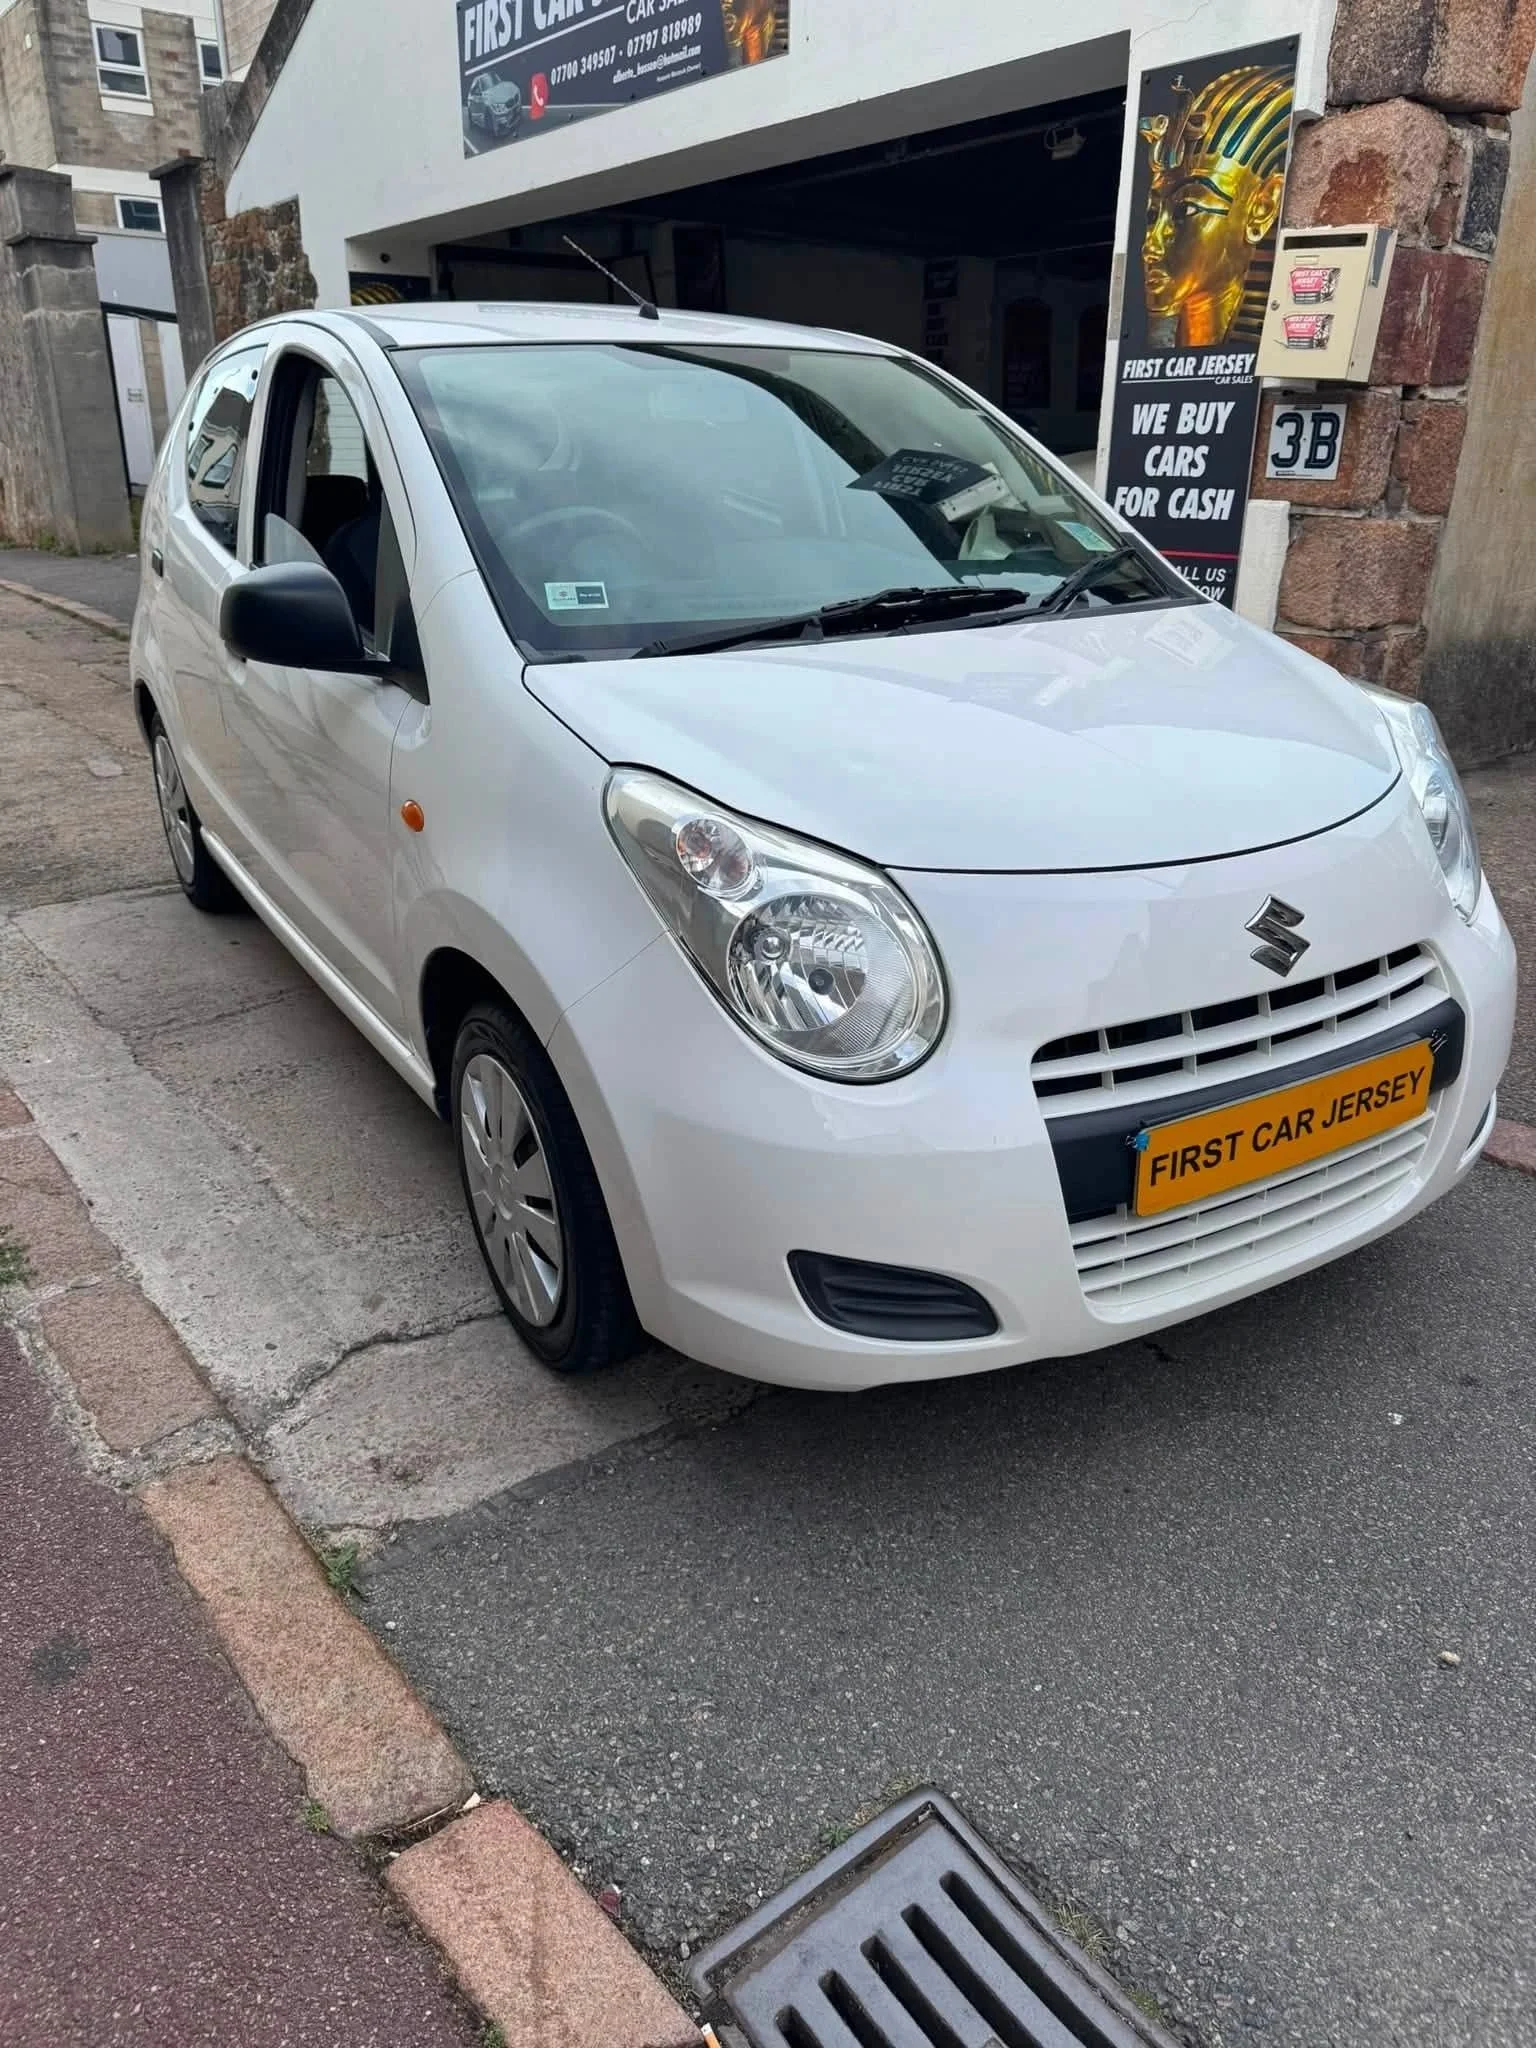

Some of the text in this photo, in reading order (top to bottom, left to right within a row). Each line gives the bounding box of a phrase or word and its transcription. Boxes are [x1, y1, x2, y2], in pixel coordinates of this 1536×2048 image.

[626, 0, 655, 24] CAR
[464, 0, 523, 62] FIRST
[550, 12, 702, 86] 07700 349507 07797 818989
[1123, 353, 1255, 379] FIRST CAR JERSEY
[1215, 375, 1254, 385] CAR SALES
[1131, 401, 1236, 435] WE BUY
[1144, 445, 1210, 478] CARS
[1114, 487, 1236, 521] FOR CASH
[1175, 566, 1227, 583] ALL US
[1150, 1066, 1427, 1187] FIRST CAR JERSEY
